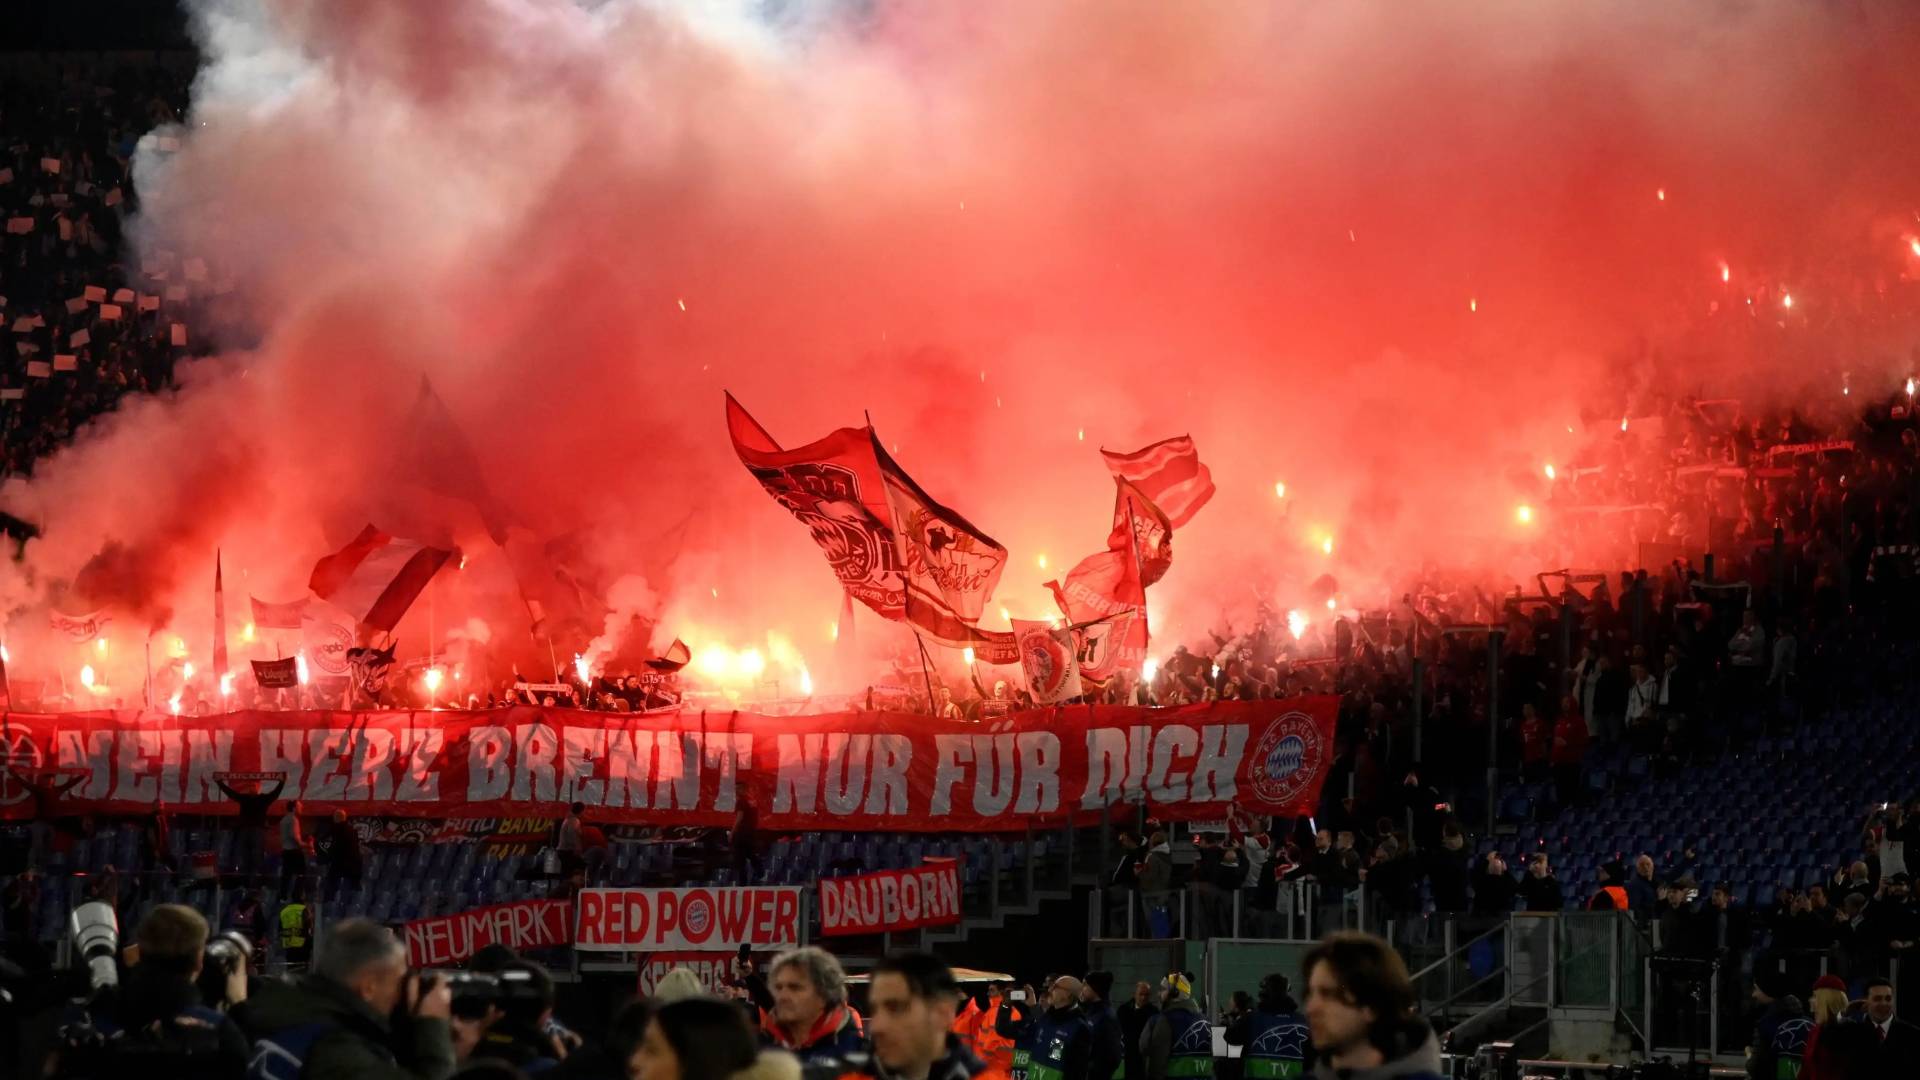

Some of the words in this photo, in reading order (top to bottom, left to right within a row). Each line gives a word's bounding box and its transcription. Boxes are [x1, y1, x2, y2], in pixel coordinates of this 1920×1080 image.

[57, 727, 234, 803] MEIN
[260, 727, 445, 802] HERZ
[467, 724, 753, 813] BRENNT
[771, 732, 912, 816] NUR
[930, 719, 1062, 817] FÜR
[1081, 723, 1250, 811] DICH
[577, 891, 650, 944] RED
[655, 889, 797, 944] POWER
[821, 868, 960, 928] DAUBORN
[404, 901, 573, 967] NEUMARKT
[1270, 1062, 1290, 1077] TV
